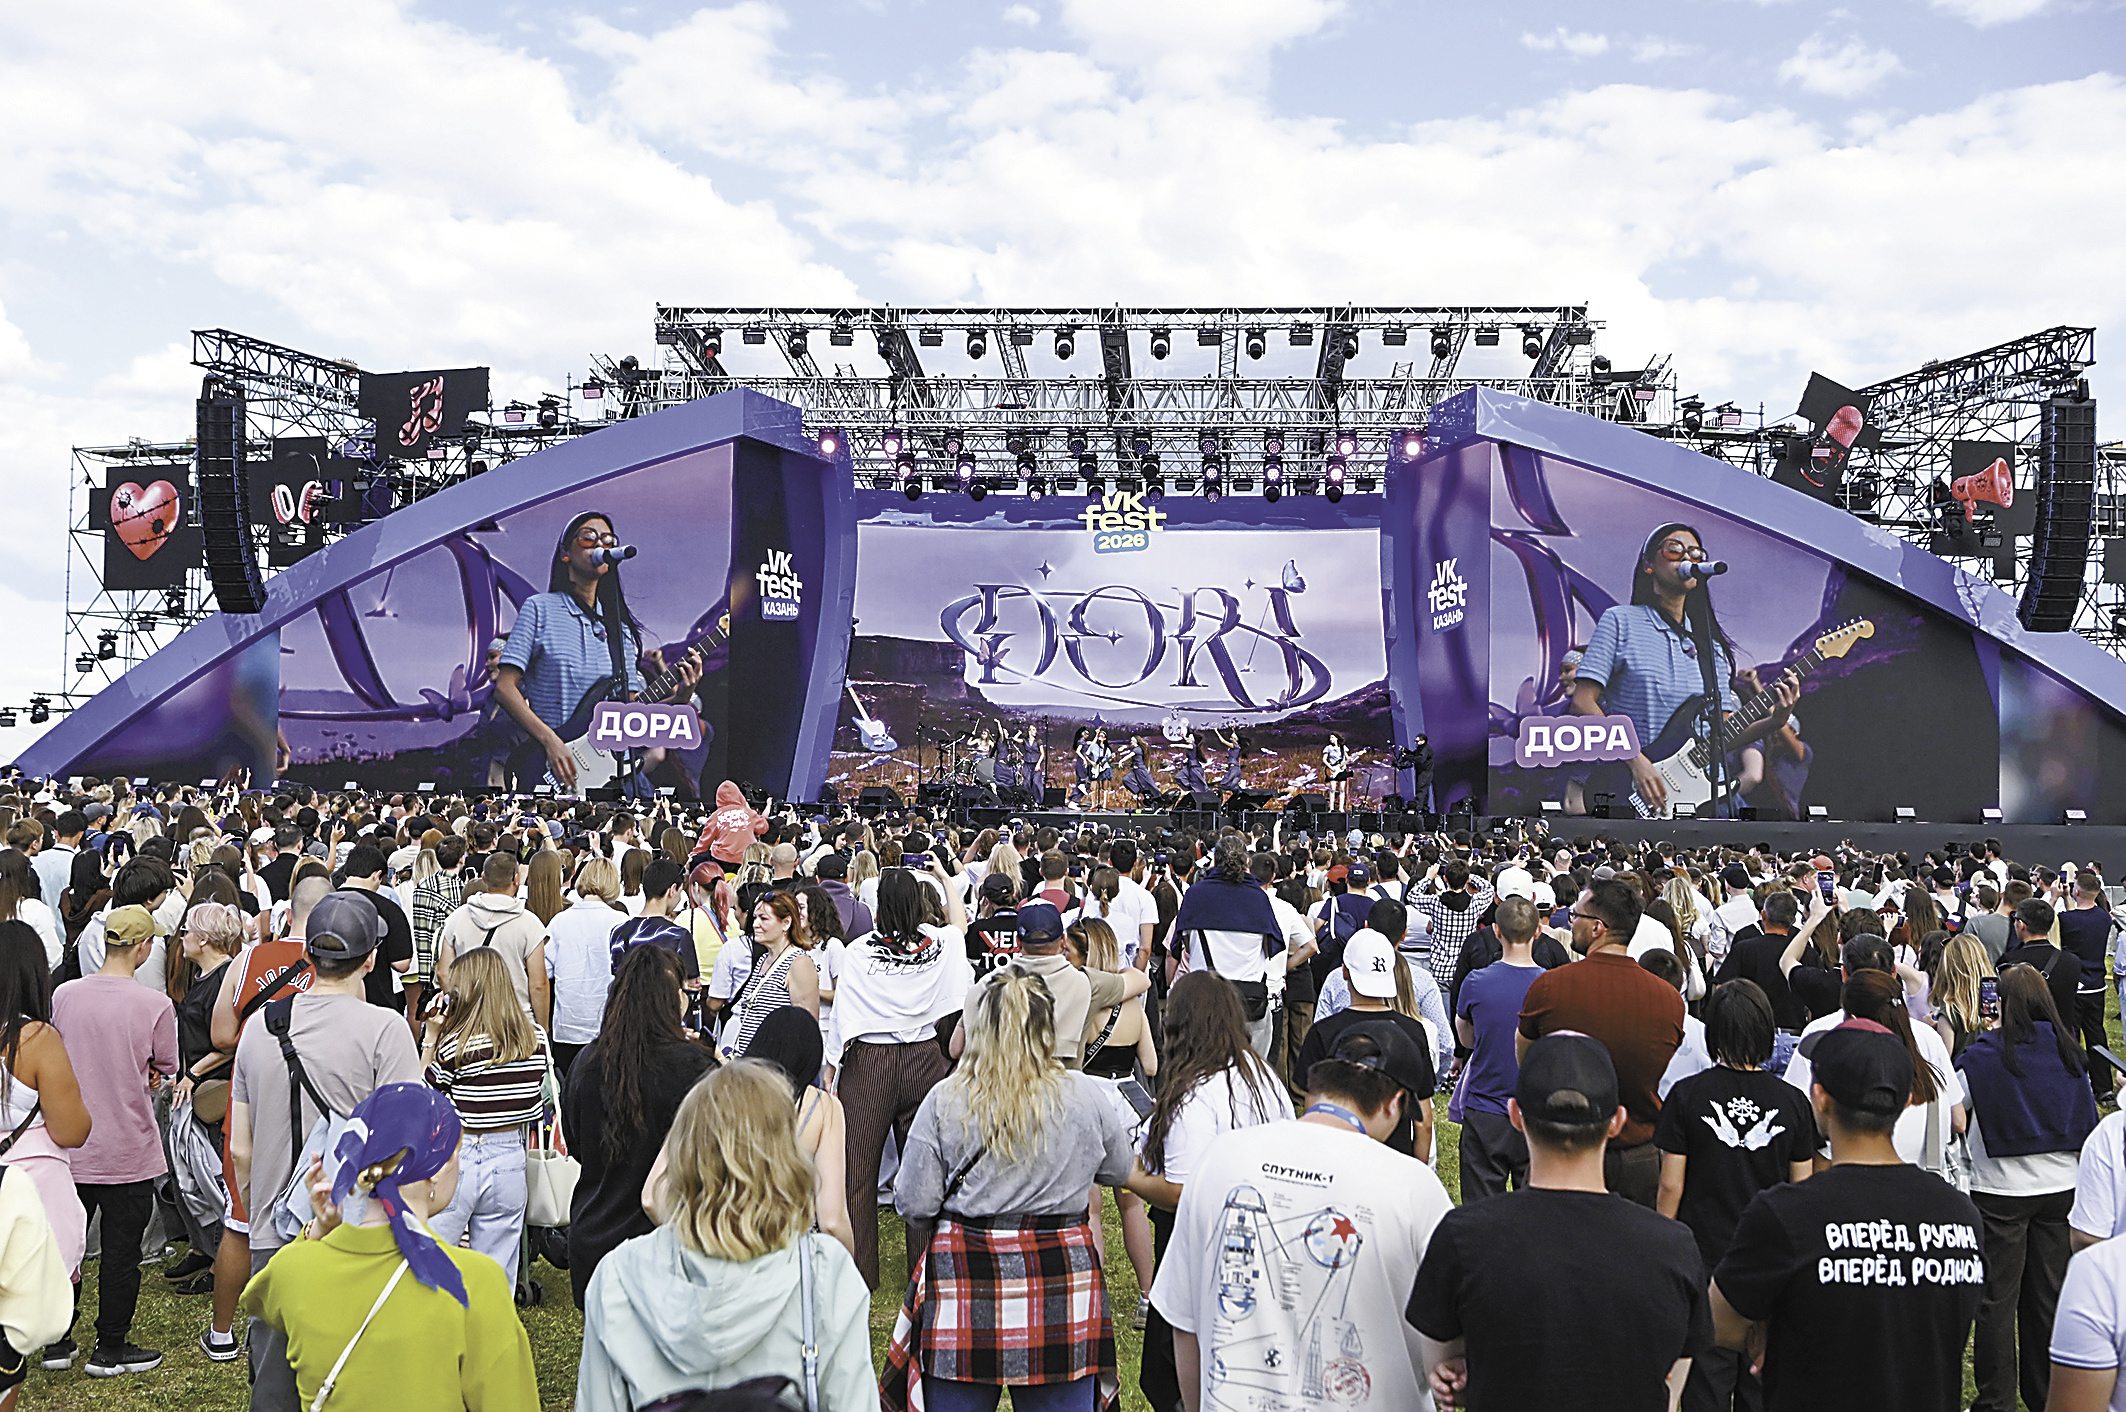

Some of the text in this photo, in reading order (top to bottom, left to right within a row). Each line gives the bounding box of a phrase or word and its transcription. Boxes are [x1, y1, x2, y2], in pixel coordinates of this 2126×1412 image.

[1102, 491, 1147, 511] VK
[1078, 505, 1167, 532] fest
[1098, 533, 1145, 549] 2026
[767, 548, 793, 577] VK
[1436, 558, 1458, 586] VK
[756, 563, 803, 603] fest
[1428, 576, 1467, 613] fest
[764, 602, 798, 616] КАЗАНЬ
[1434, 609, 1463, 630] КАЗАНЬ
[597, 711, 693, 742] ДОРА
[1525, 725, 1632, 757] ДОРА
[1086, 1036, 1104, 1056] GUESS
[1262, 1163, 1334, 1183] СПУТНИК-1
[1825, 1219, 1979, 1252] ВПЕРЁД, РУБИН!
[1818, 1253, 1907, 1287] ВПЕРЁД,
